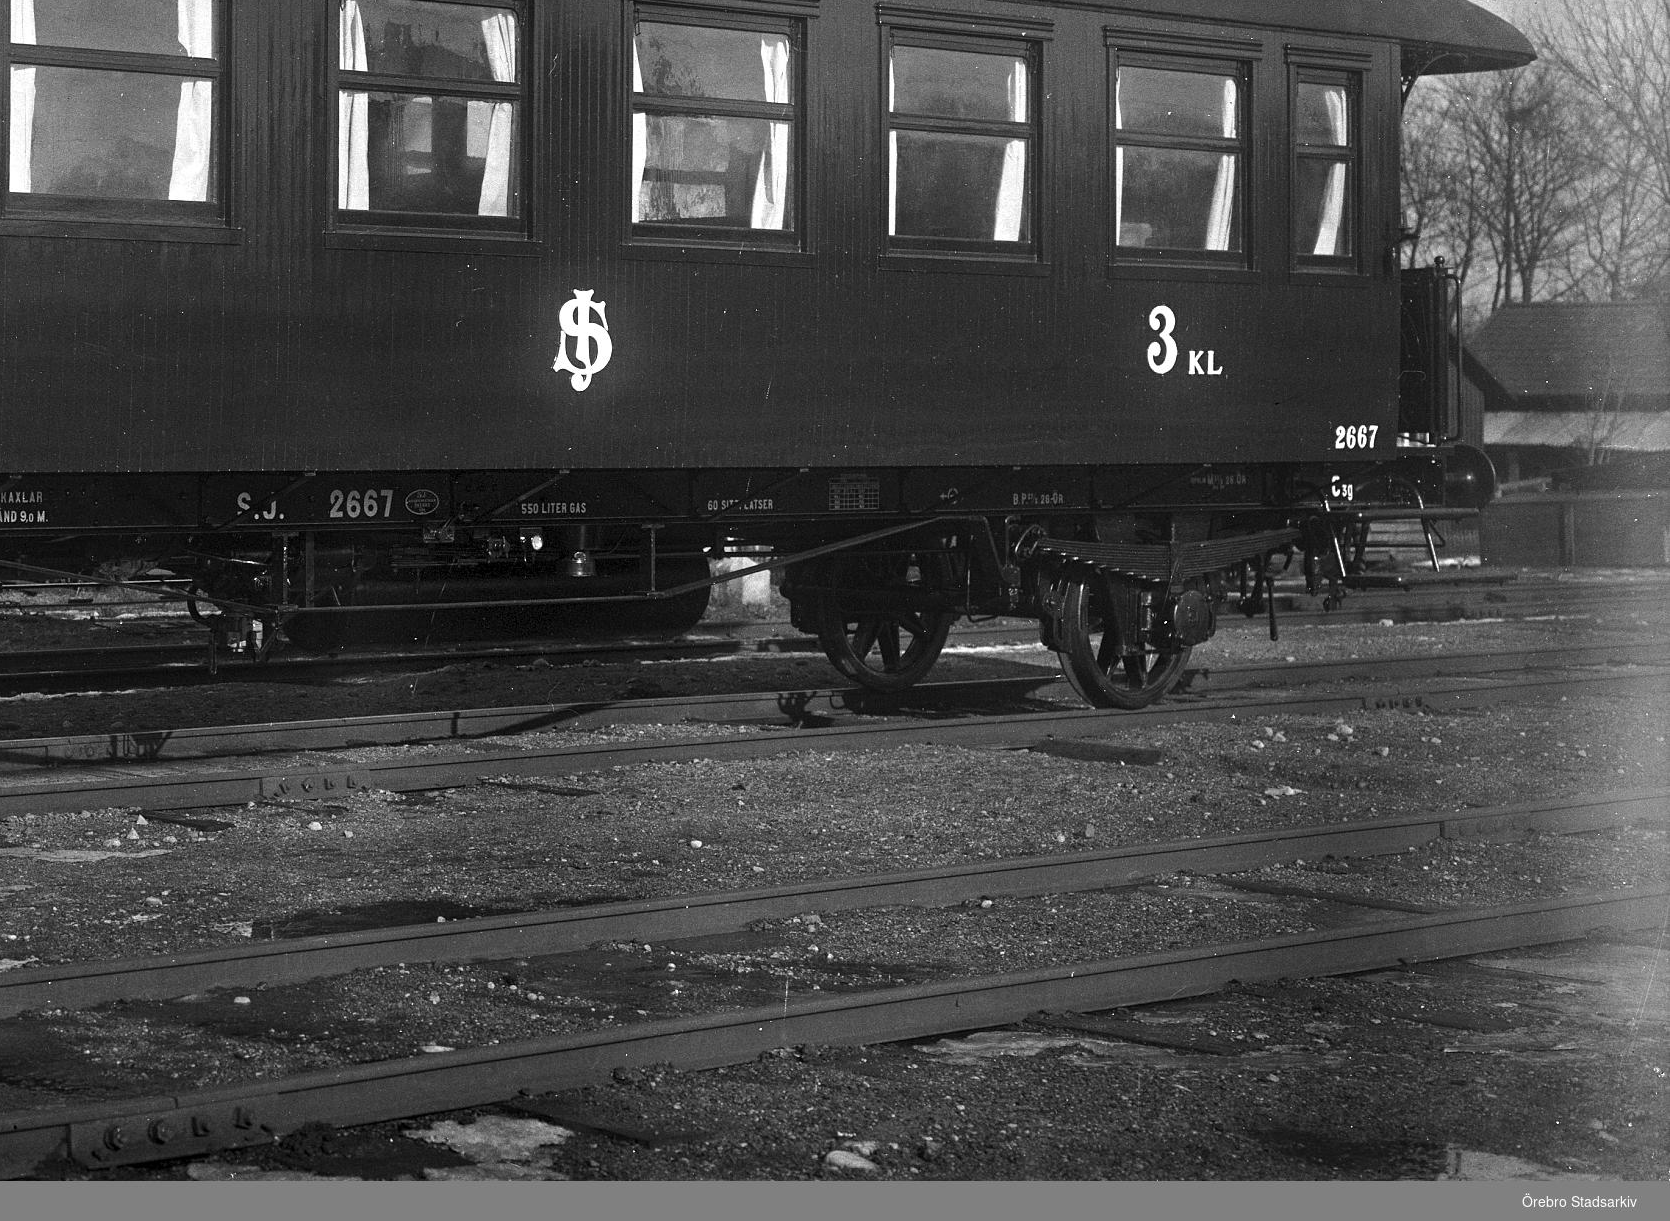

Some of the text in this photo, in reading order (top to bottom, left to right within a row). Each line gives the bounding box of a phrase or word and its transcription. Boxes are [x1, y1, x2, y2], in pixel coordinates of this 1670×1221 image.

[1147, 305, 1223, 375] 3 KL
[1335, 424, 1379, 449] 2667
[329, 488, 394, 518] 2667
[521, 501, 587, 515] 550 LITER GAS
